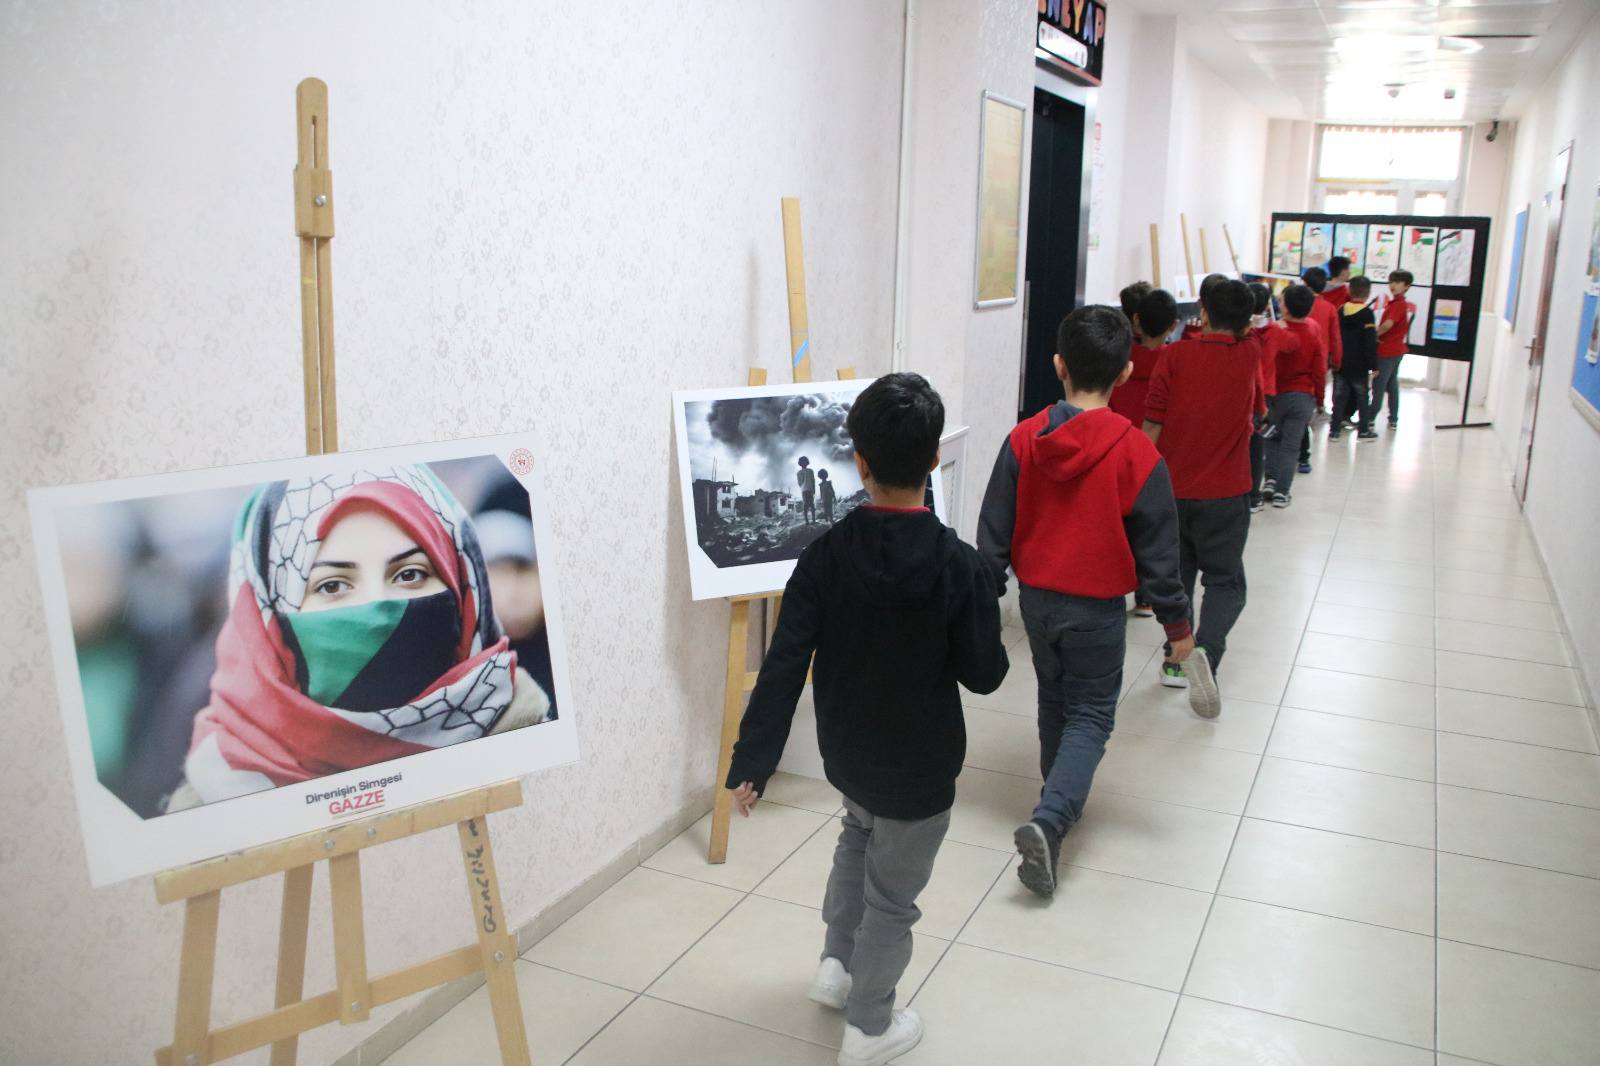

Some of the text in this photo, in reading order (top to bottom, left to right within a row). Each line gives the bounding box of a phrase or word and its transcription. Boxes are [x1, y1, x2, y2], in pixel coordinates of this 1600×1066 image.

[305, 772, 403, 804] Direnişin Simgesi
[329, 789, 385, 815] GAZZE
